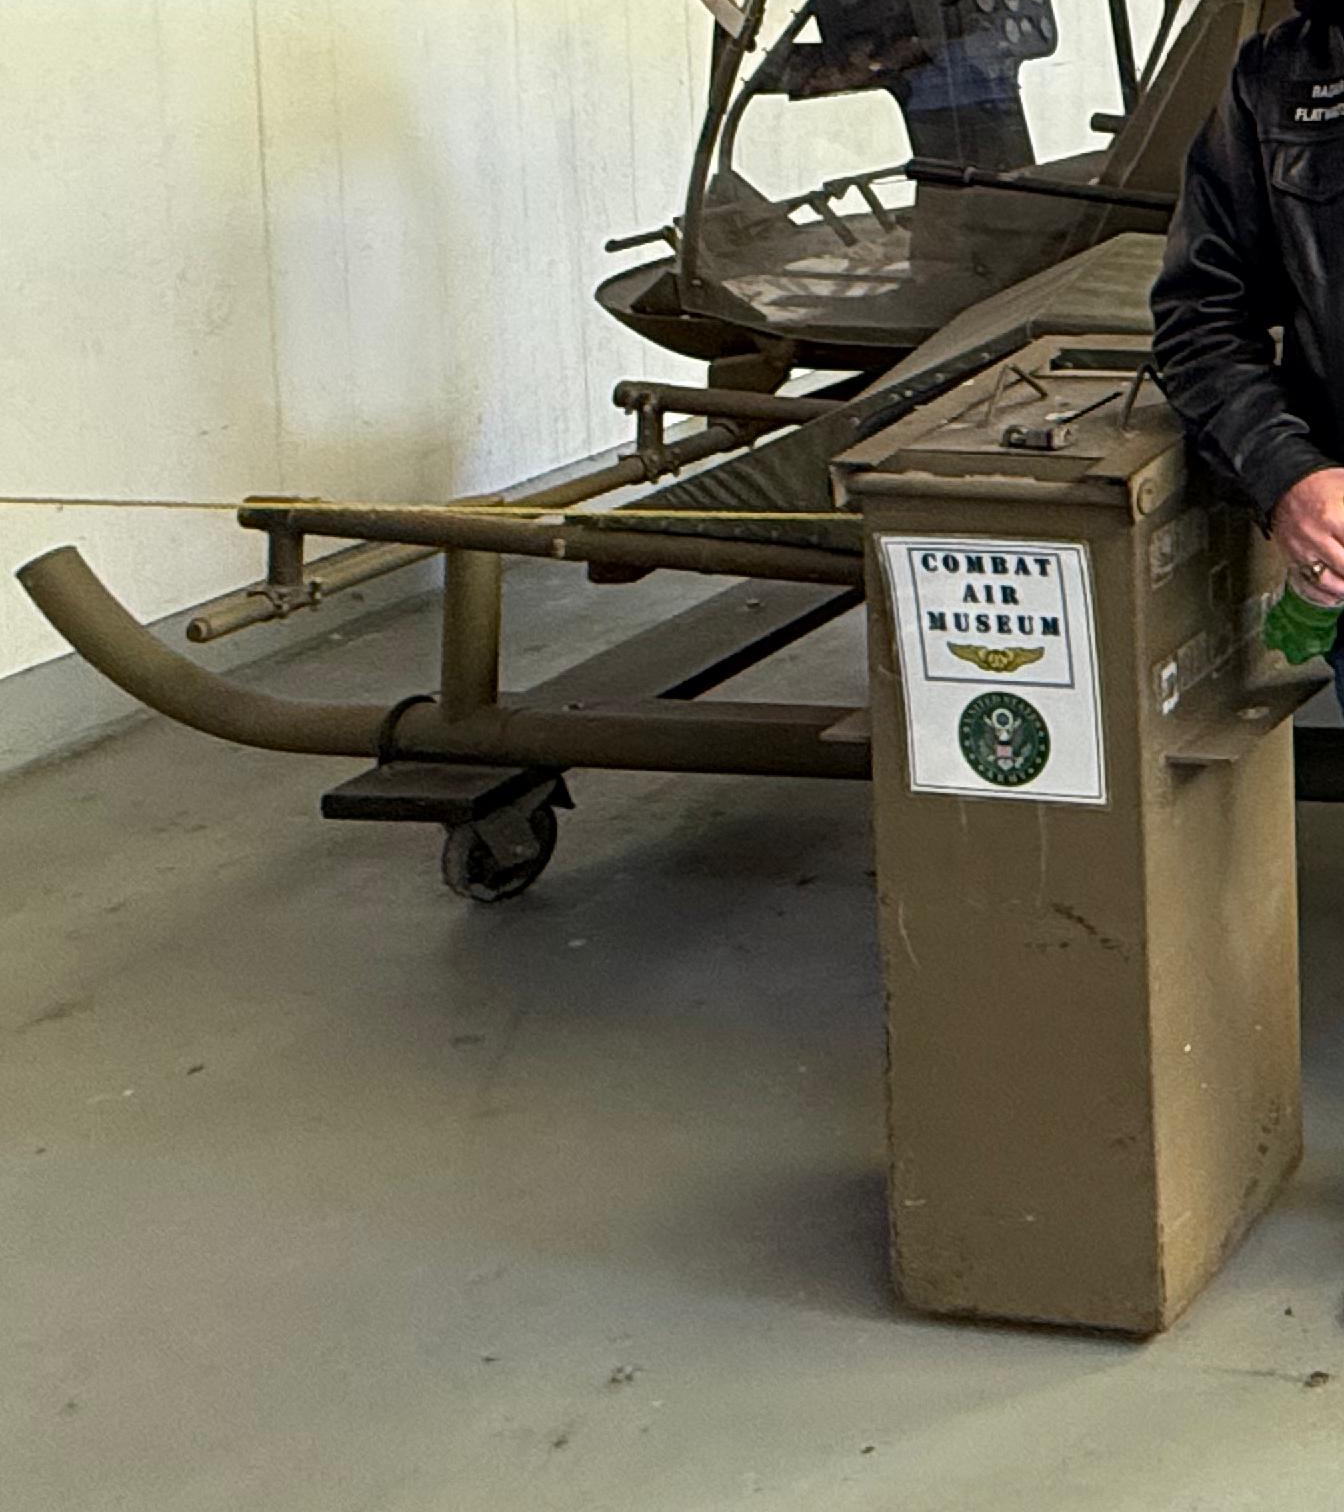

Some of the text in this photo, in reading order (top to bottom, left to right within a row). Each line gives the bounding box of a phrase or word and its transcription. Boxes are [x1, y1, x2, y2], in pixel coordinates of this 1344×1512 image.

[920, 552, 1051, 578] COMBAT
[962, 583, 1020, 606] AIR
[926, 610, 1062, 637] MUSEUM
